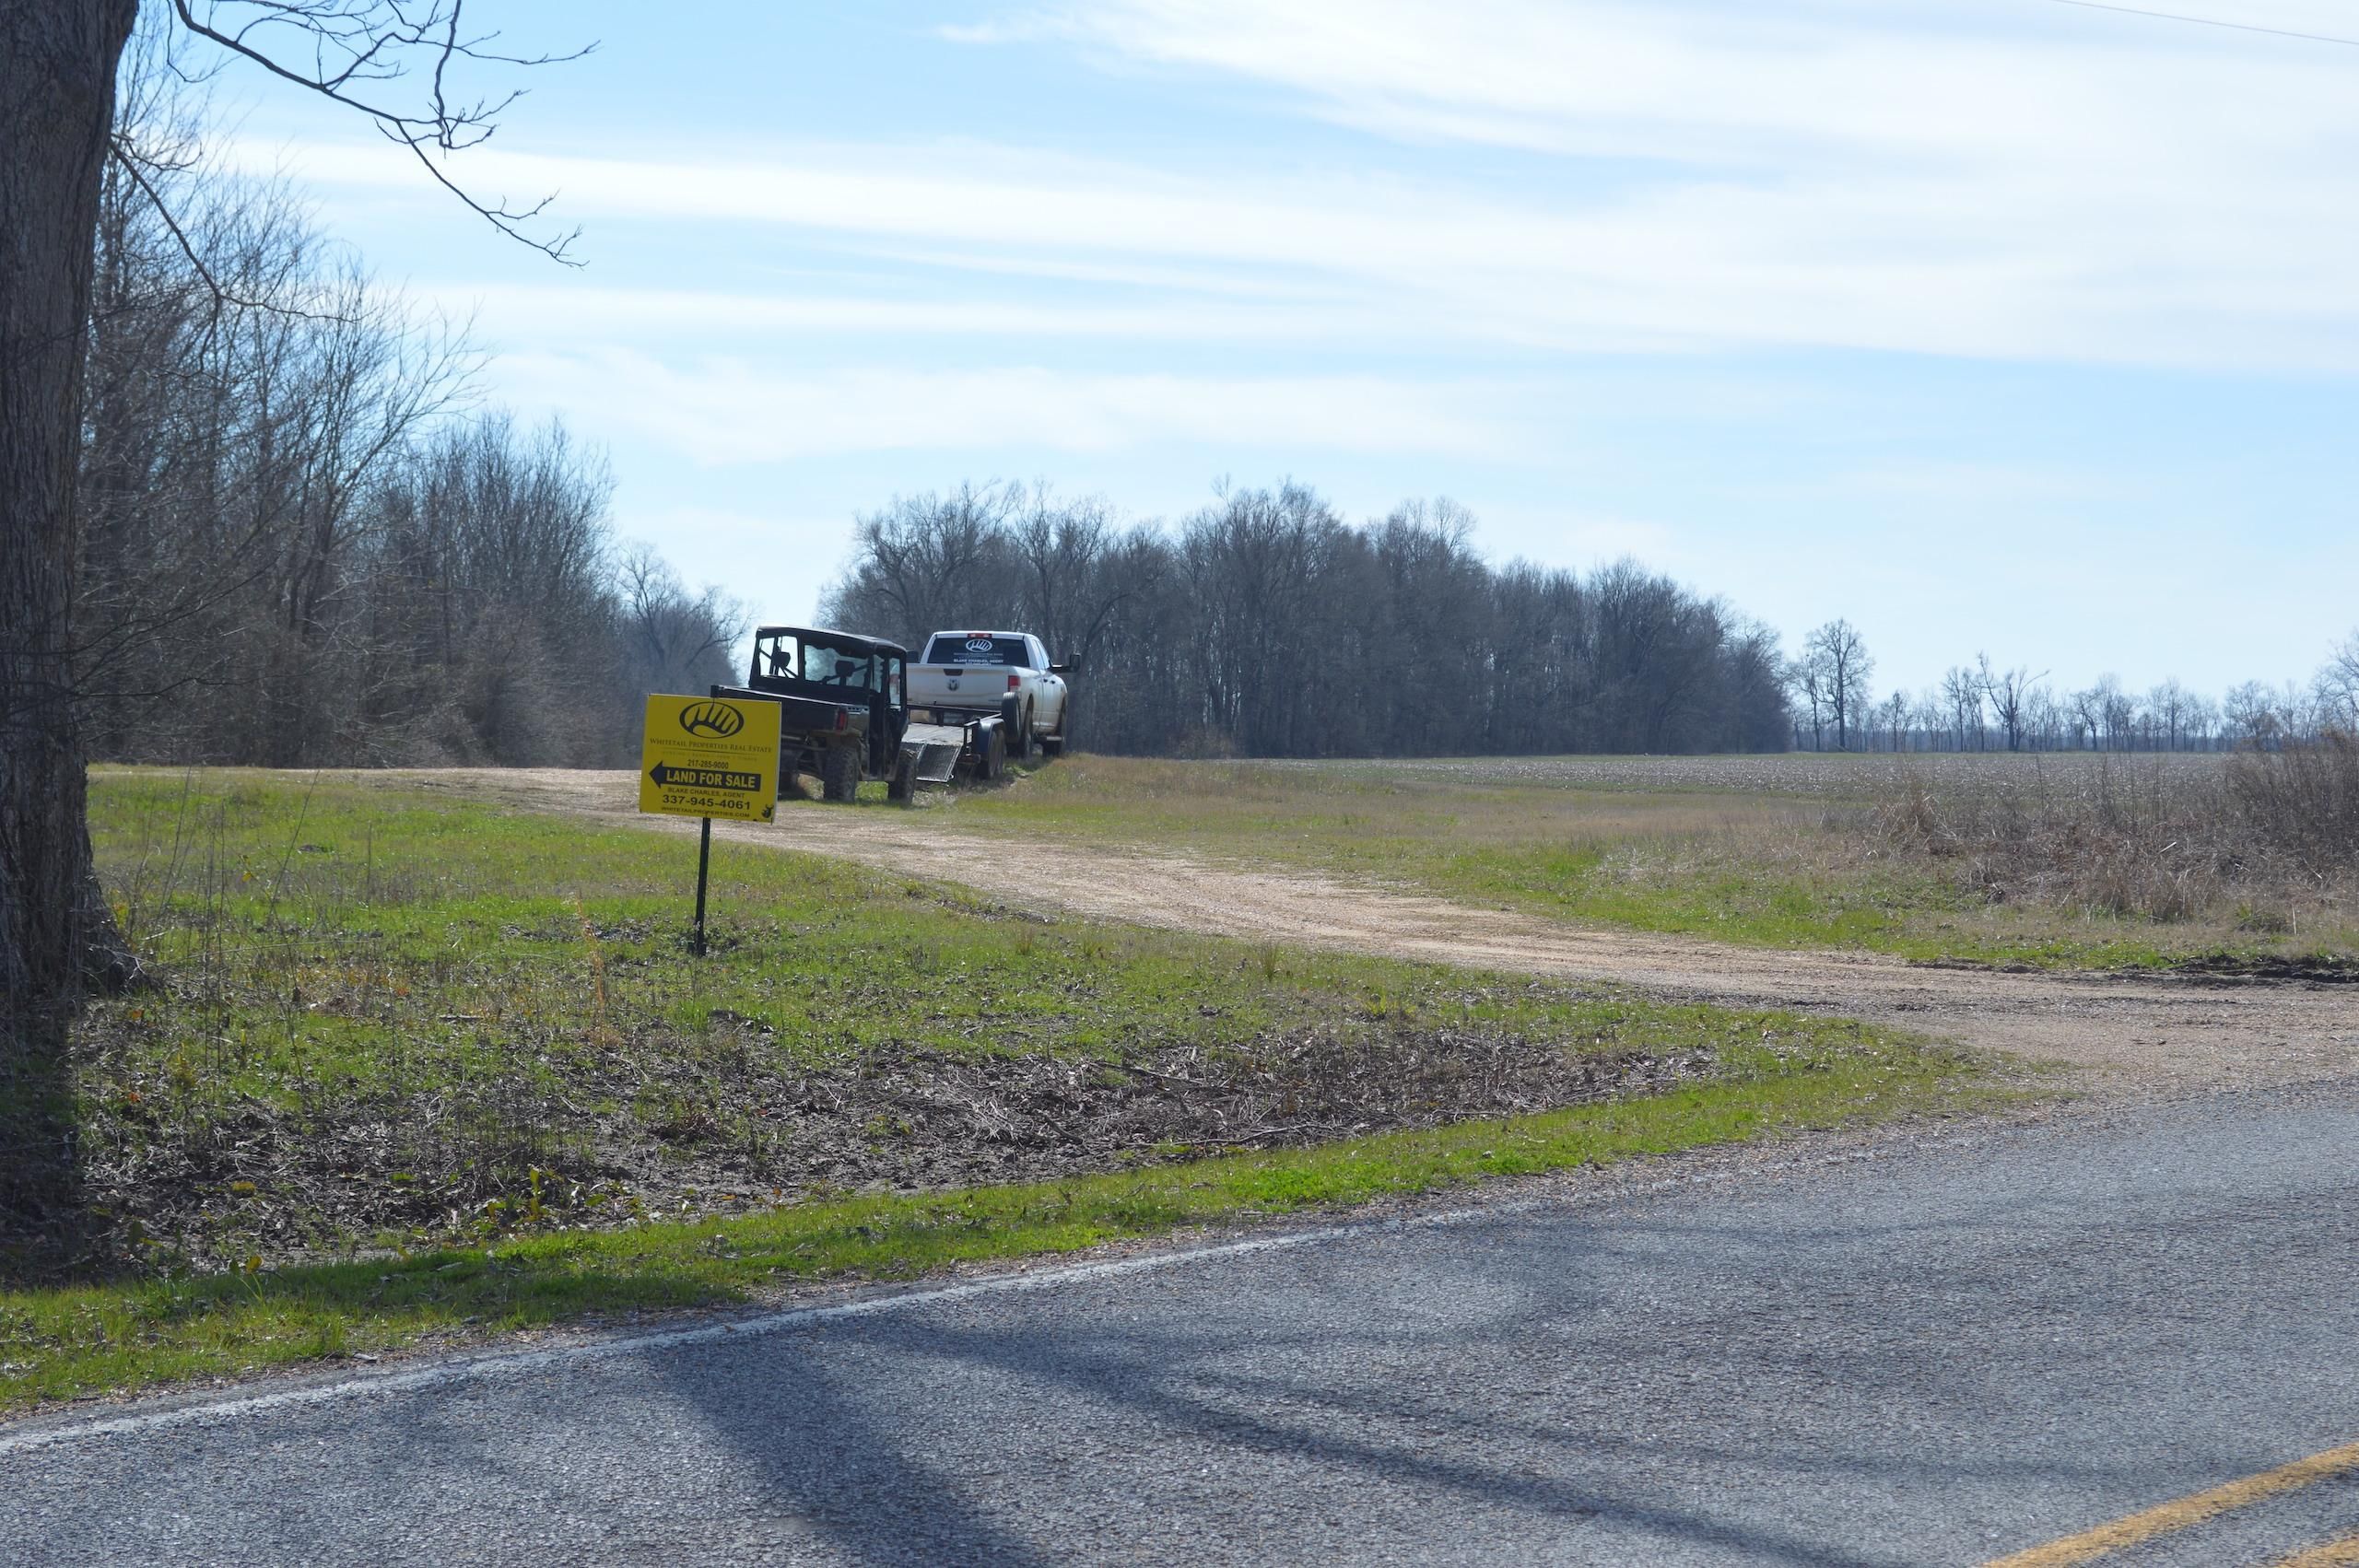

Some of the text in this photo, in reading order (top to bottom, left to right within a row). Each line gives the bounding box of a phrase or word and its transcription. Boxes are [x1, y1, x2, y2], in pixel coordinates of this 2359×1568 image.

[687, 759, 729, 769] 217-285-9000
[666, 770, 756, 789] LAND FOR SALE
[663, 794, 751, 810] 337-945-4061
